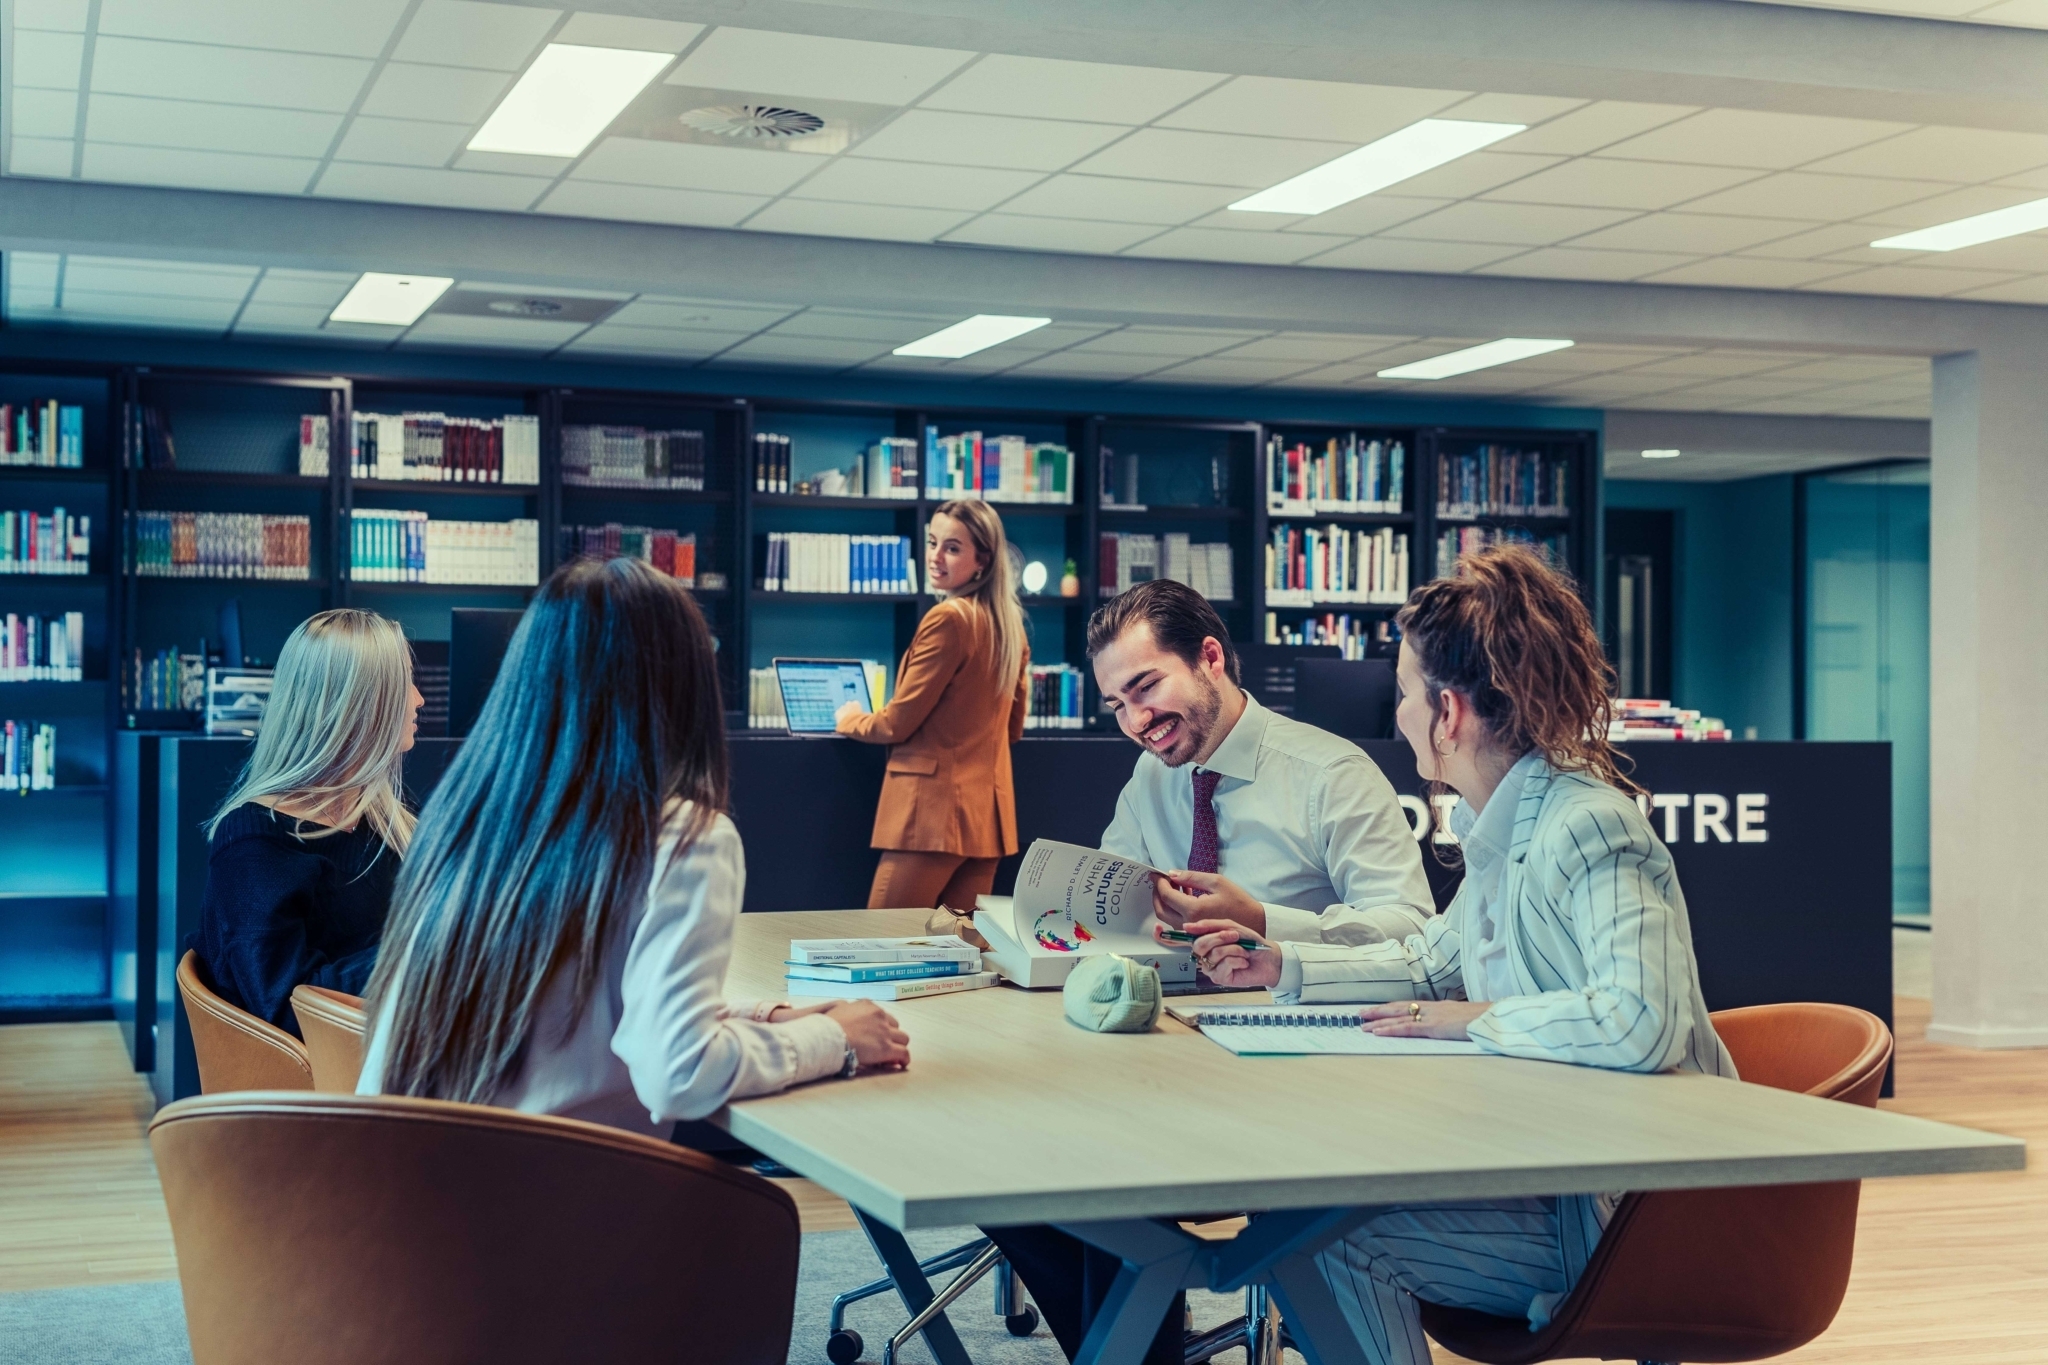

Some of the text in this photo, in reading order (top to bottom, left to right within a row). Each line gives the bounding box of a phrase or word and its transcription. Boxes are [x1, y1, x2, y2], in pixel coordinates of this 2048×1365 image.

[1636, 793, 1769, 843] TRE
[1065, 855, 1088, 921] RICHARD D. LEWIS
[1083, 857, 1109, 895] WHEN
[1096, 860, 1124, 925] CULTURES
[1110, 864, 1139, 916] COLLIDE
[901, 986, 914, 994] David
